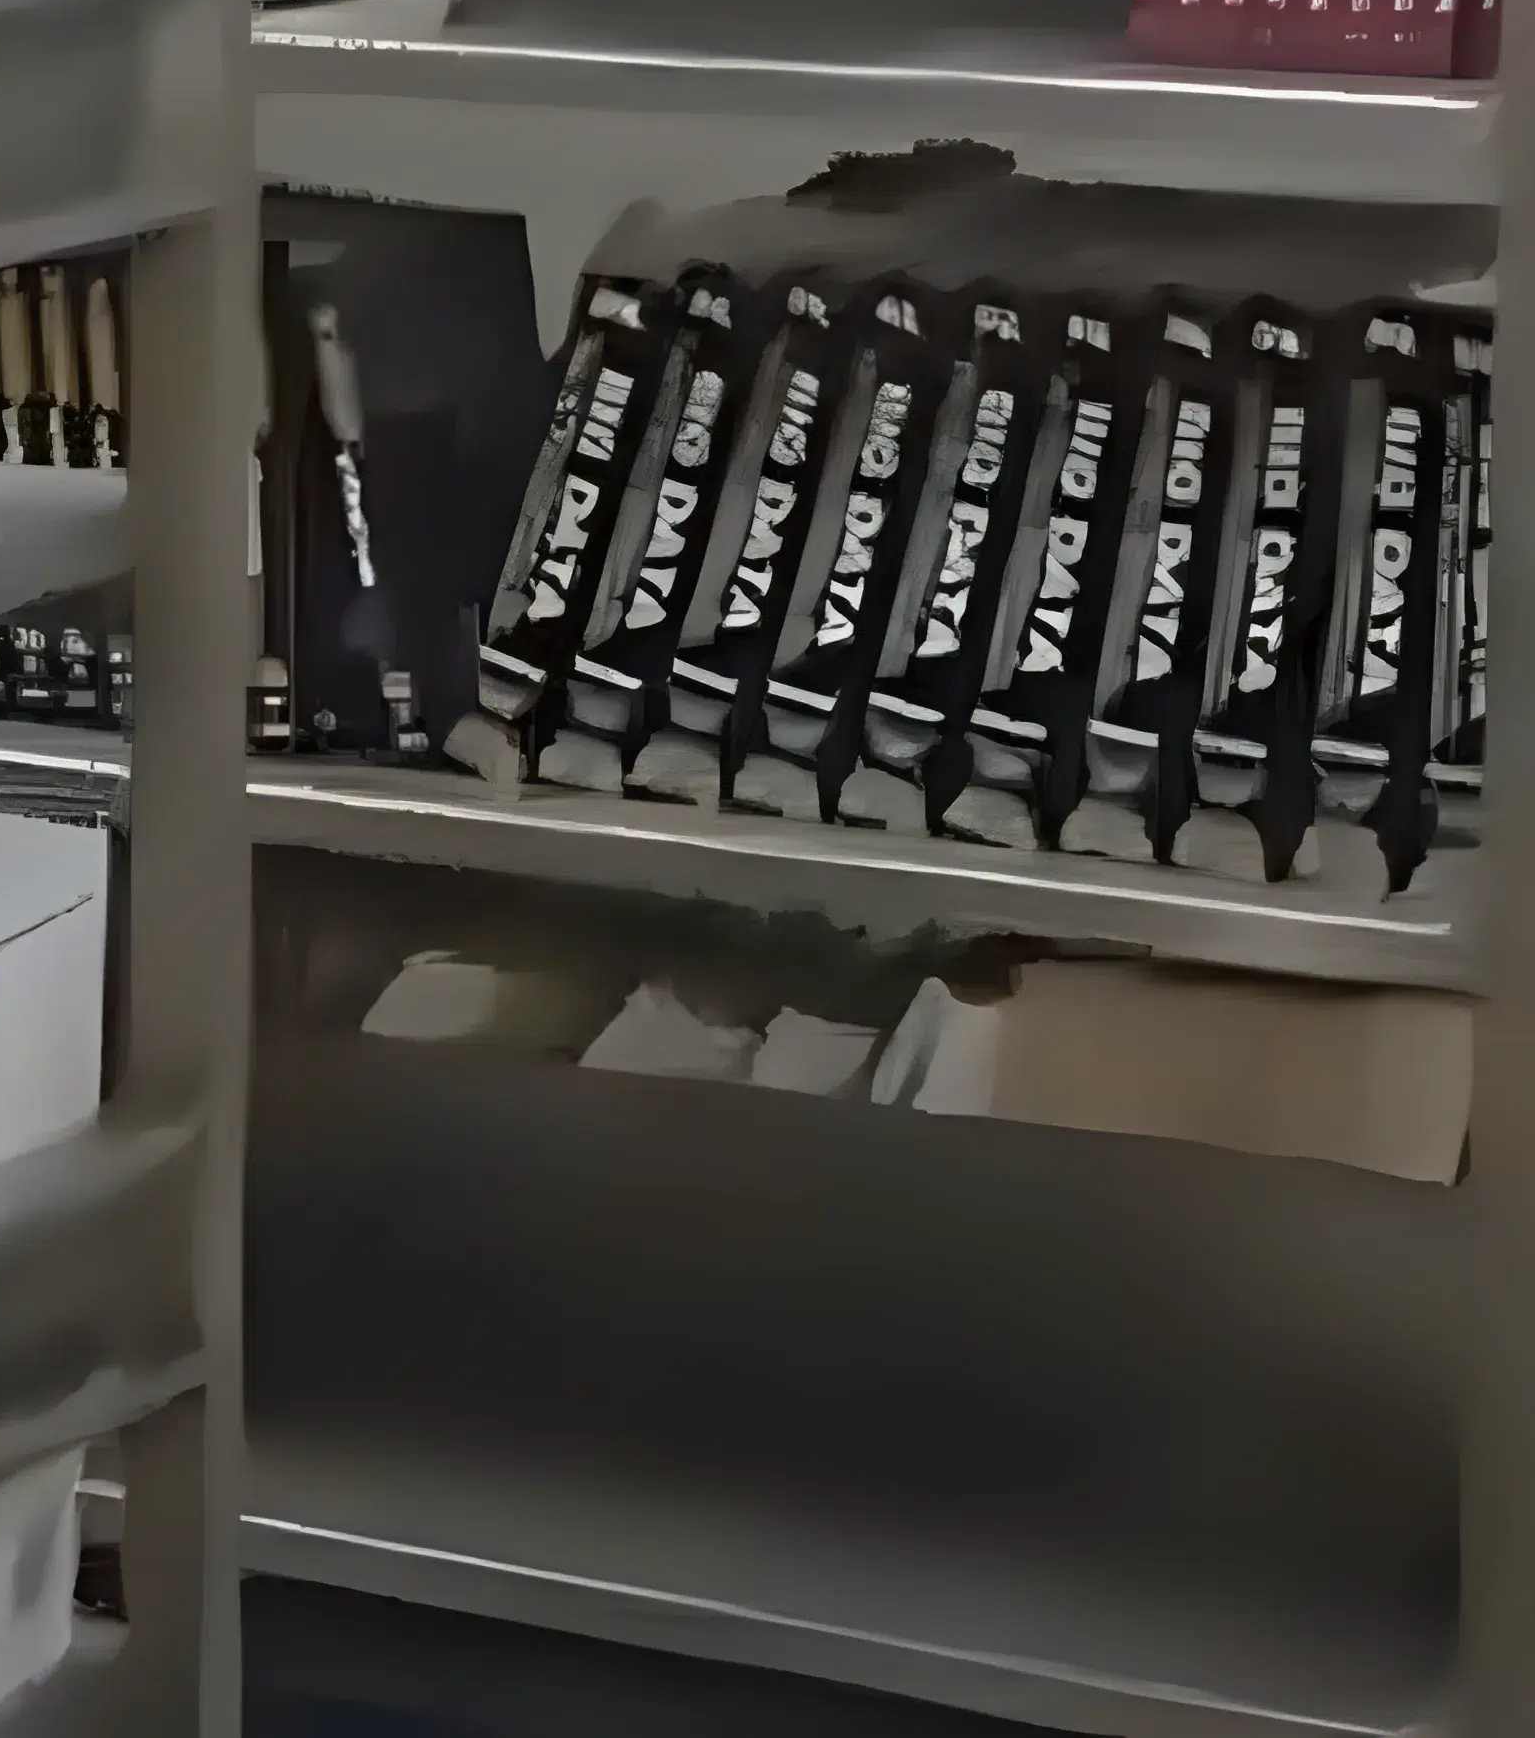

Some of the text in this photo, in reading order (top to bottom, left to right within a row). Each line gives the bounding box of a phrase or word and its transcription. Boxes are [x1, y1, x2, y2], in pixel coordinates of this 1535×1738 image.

[528, 475, 600, 620] DATA
[626, 478, 698, 628] DATA
[724, 478, 793, 627] DATA
[817, 495, 883, 646] DATA
[918, 504, 988, 656] DATA
[1020, 516, 1088, 671] DATA
[1137, 522, 1192, 681] DATA
[1239, 530, 1296, 692] DATA
[1361, 529, 1411, 695] DATA
